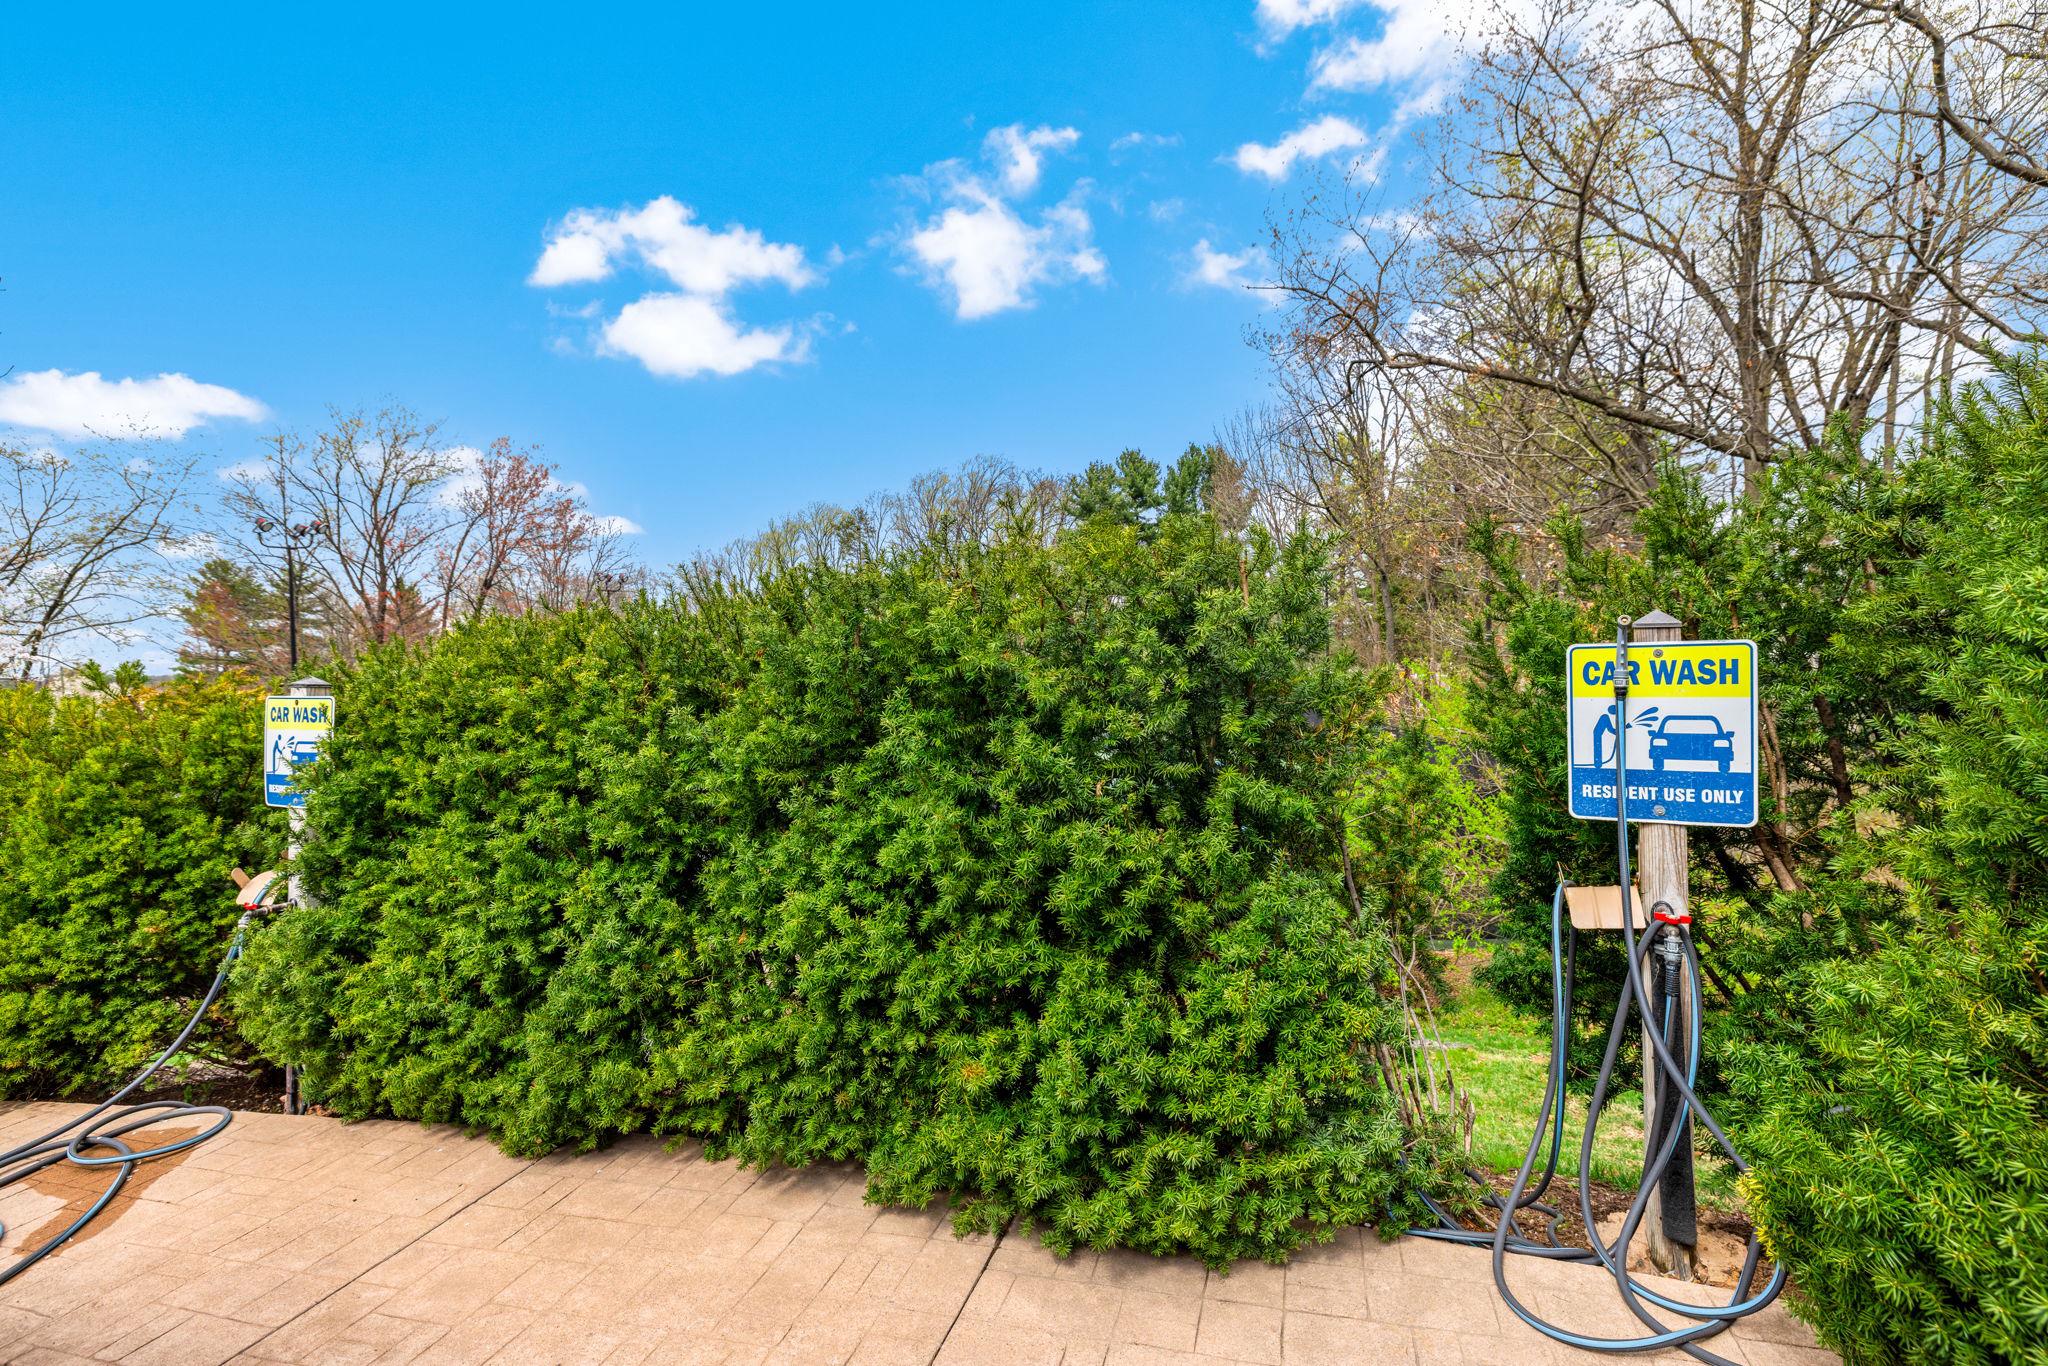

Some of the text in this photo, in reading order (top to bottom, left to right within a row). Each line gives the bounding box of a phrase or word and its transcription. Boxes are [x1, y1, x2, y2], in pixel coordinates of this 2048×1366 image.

[1582, 658, 1739, 686] CAR WASH
[270, 706, 327, 723] CAR WASH
[1582, 784, 1743, 804] RESIENT USE ONLY
